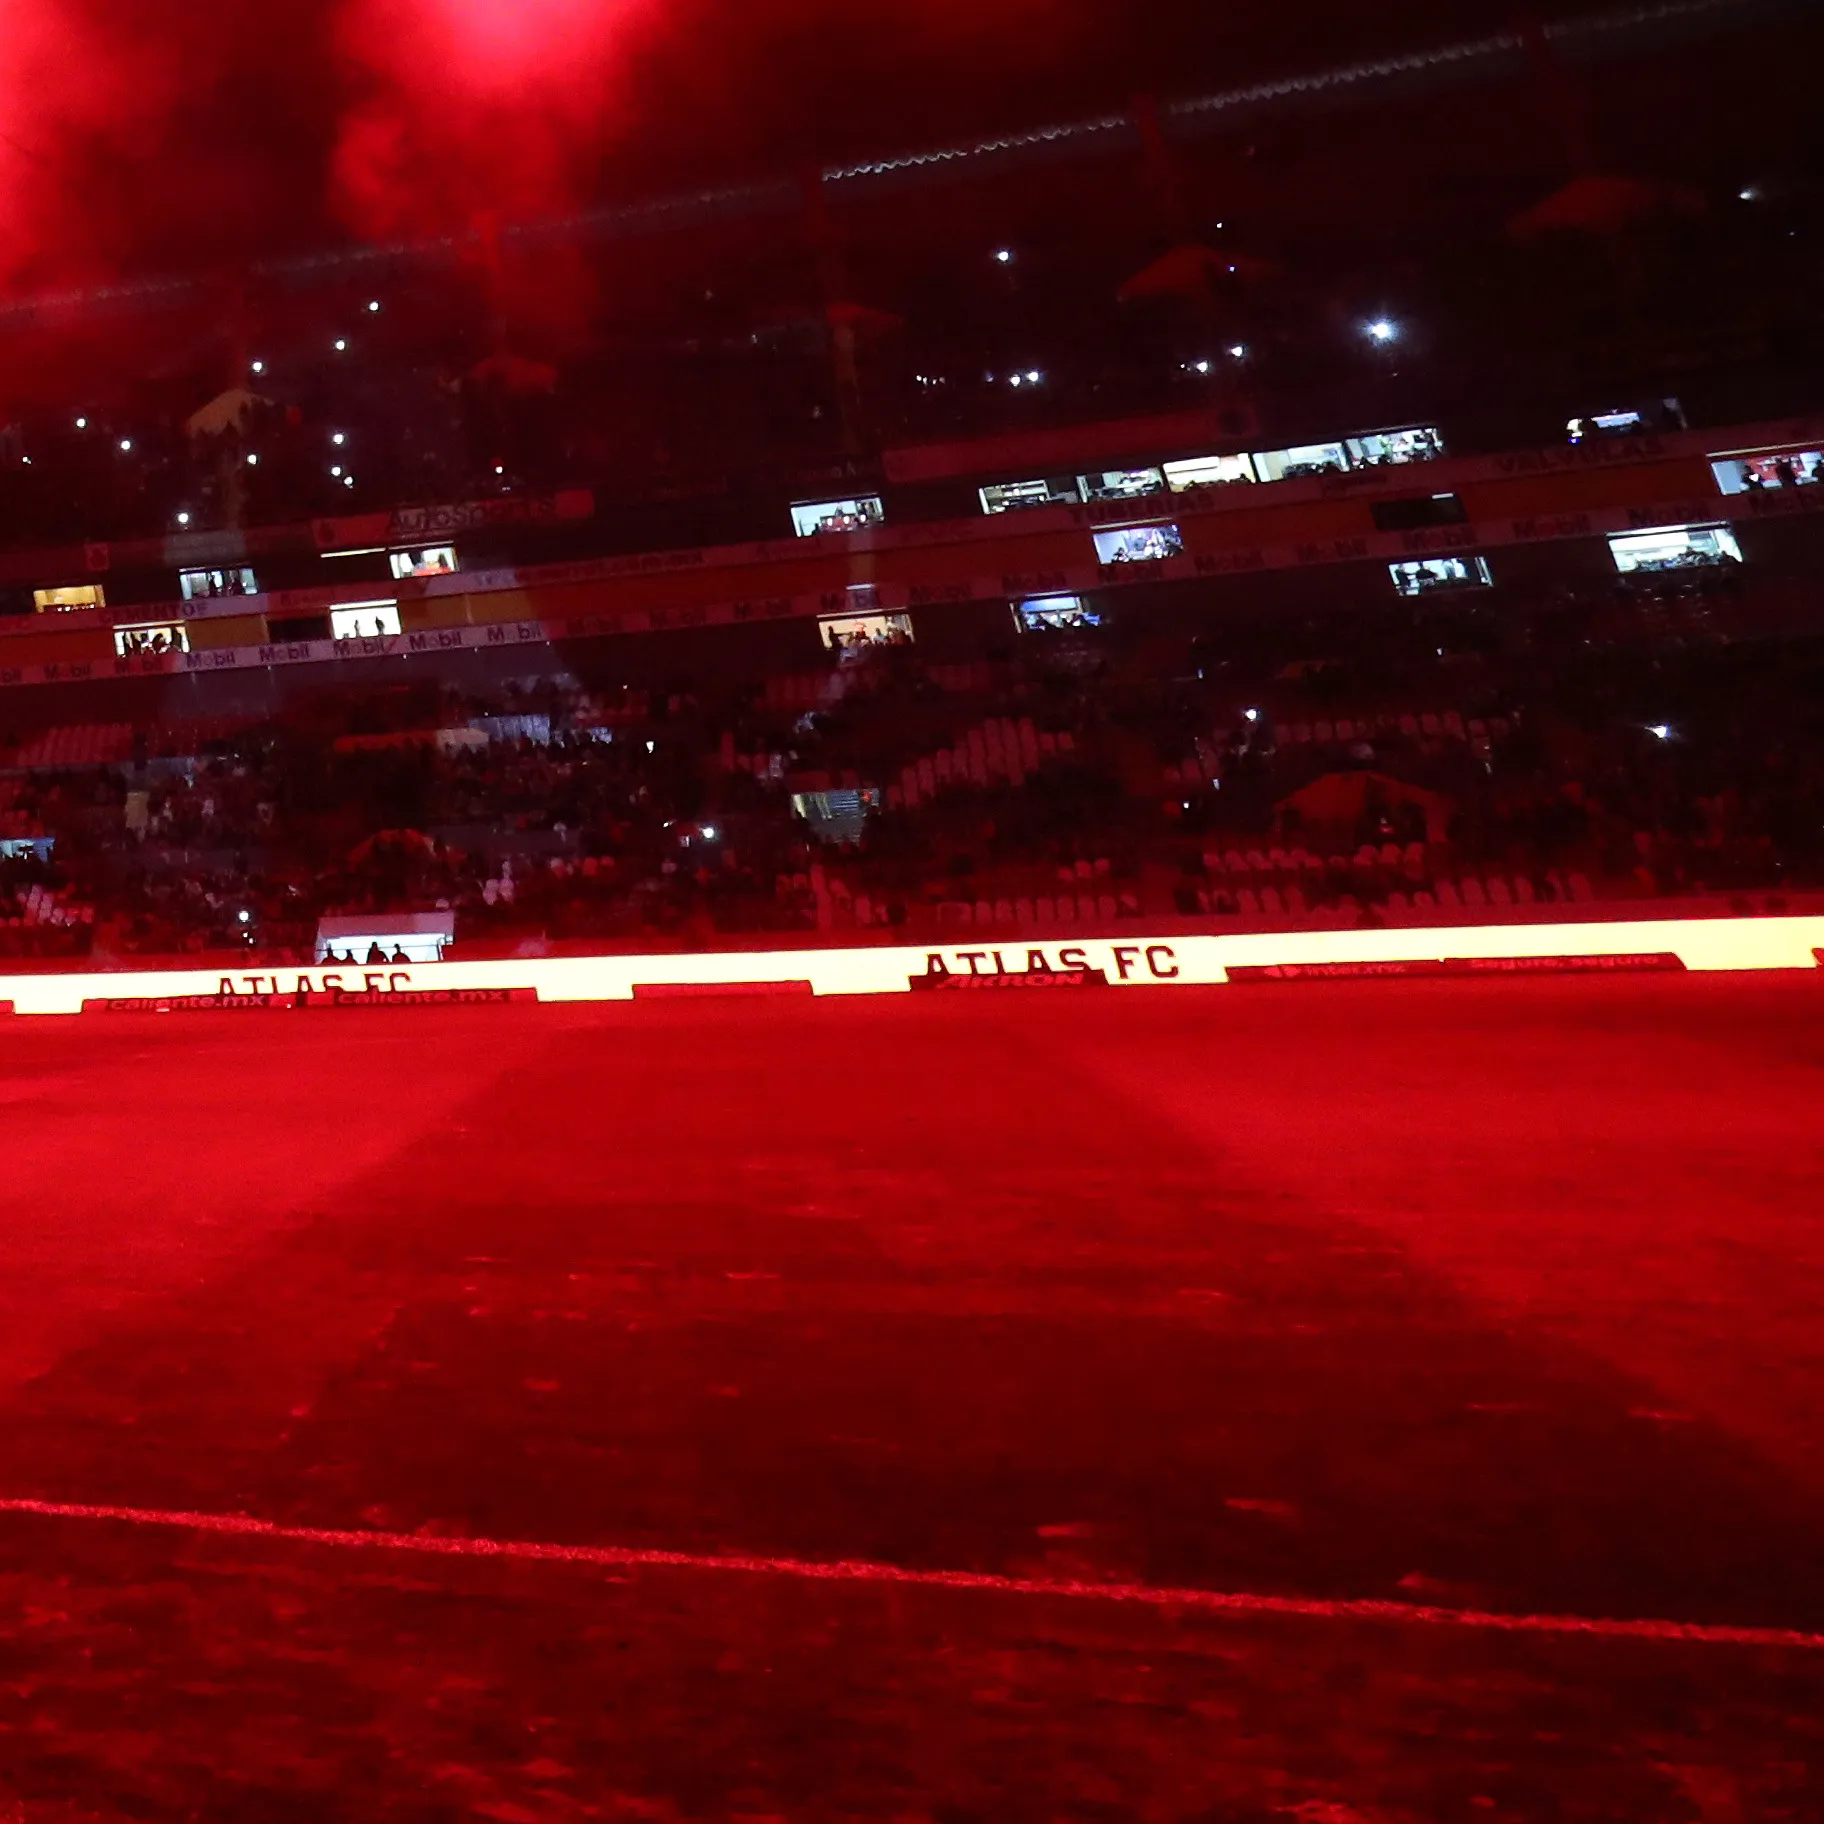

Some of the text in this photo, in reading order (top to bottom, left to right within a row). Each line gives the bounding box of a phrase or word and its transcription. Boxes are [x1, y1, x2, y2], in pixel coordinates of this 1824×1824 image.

[409, 633, 462, 650] Mobil
[488, 626, 541, 642] Mobil
[259, 646, 308, 662] Mobil
[334, 640, 383, 655] Mobil
[186, 651, 235, 666] Mobil
[1112, 945, 1179, 979] FC
[111, 996, 264, 1010] caliente.mx
[338, 991, 505, 1005] caliente.mx
